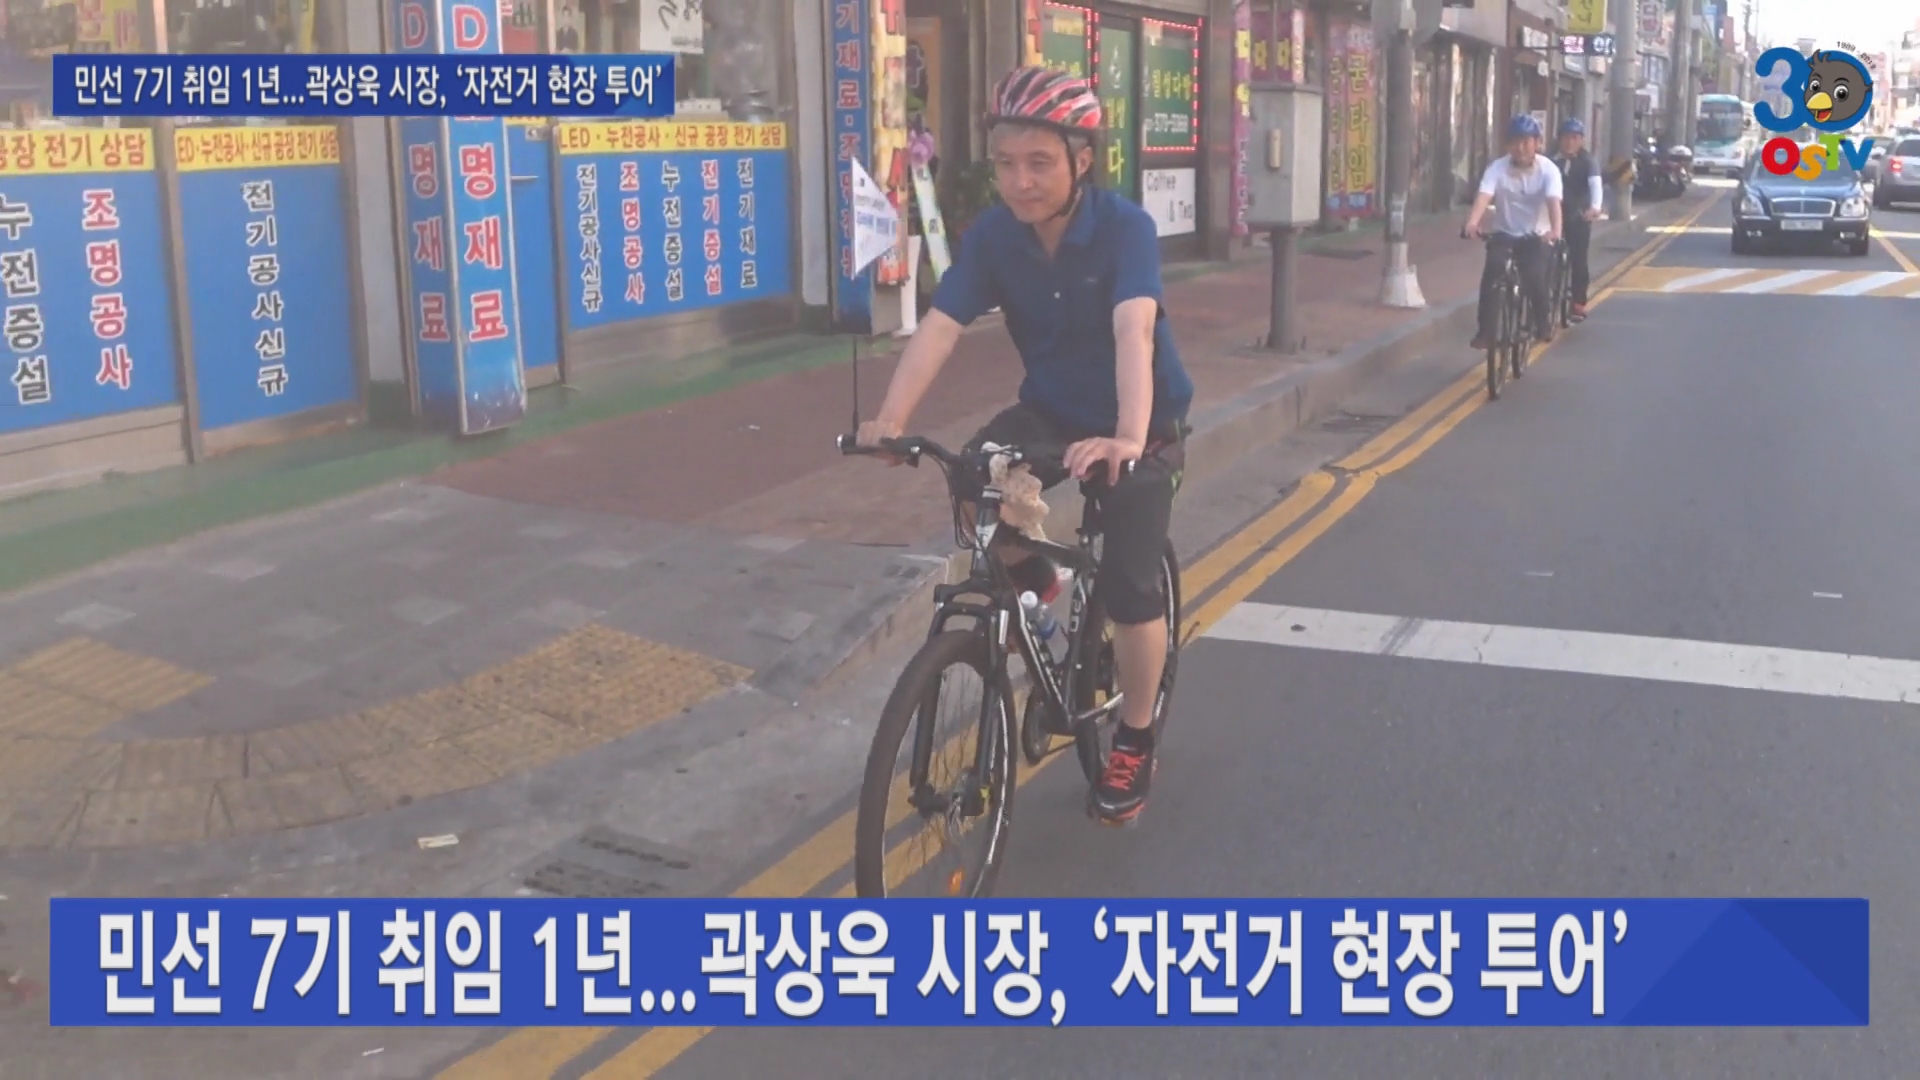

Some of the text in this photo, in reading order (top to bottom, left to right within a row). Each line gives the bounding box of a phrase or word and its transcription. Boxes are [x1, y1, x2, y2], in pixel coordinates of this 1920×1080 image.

[44, 132, 92, 169] 전기
[100, 132, 146, 168] 상담
[559, 125, 782, 148] LED 누전공사 신규 공장 전기 상담
[82, 189, 133, 389] 조명공사
[241, 180, 289, 397] 전기공사신규
[407, 117, 450, 342] 명재료
[455, 117, 508, 342] 명재료
[577, 163, 603, 313] 전기공사신규
[620, 162, 645, 305] 조명공사
[662, 160, 684, 301] 누전증설
[702, 159, 722, 295] 전기증설
[737, 158, 757, 288] 전기재료
[0, 193, 51, 405] 누전증설
